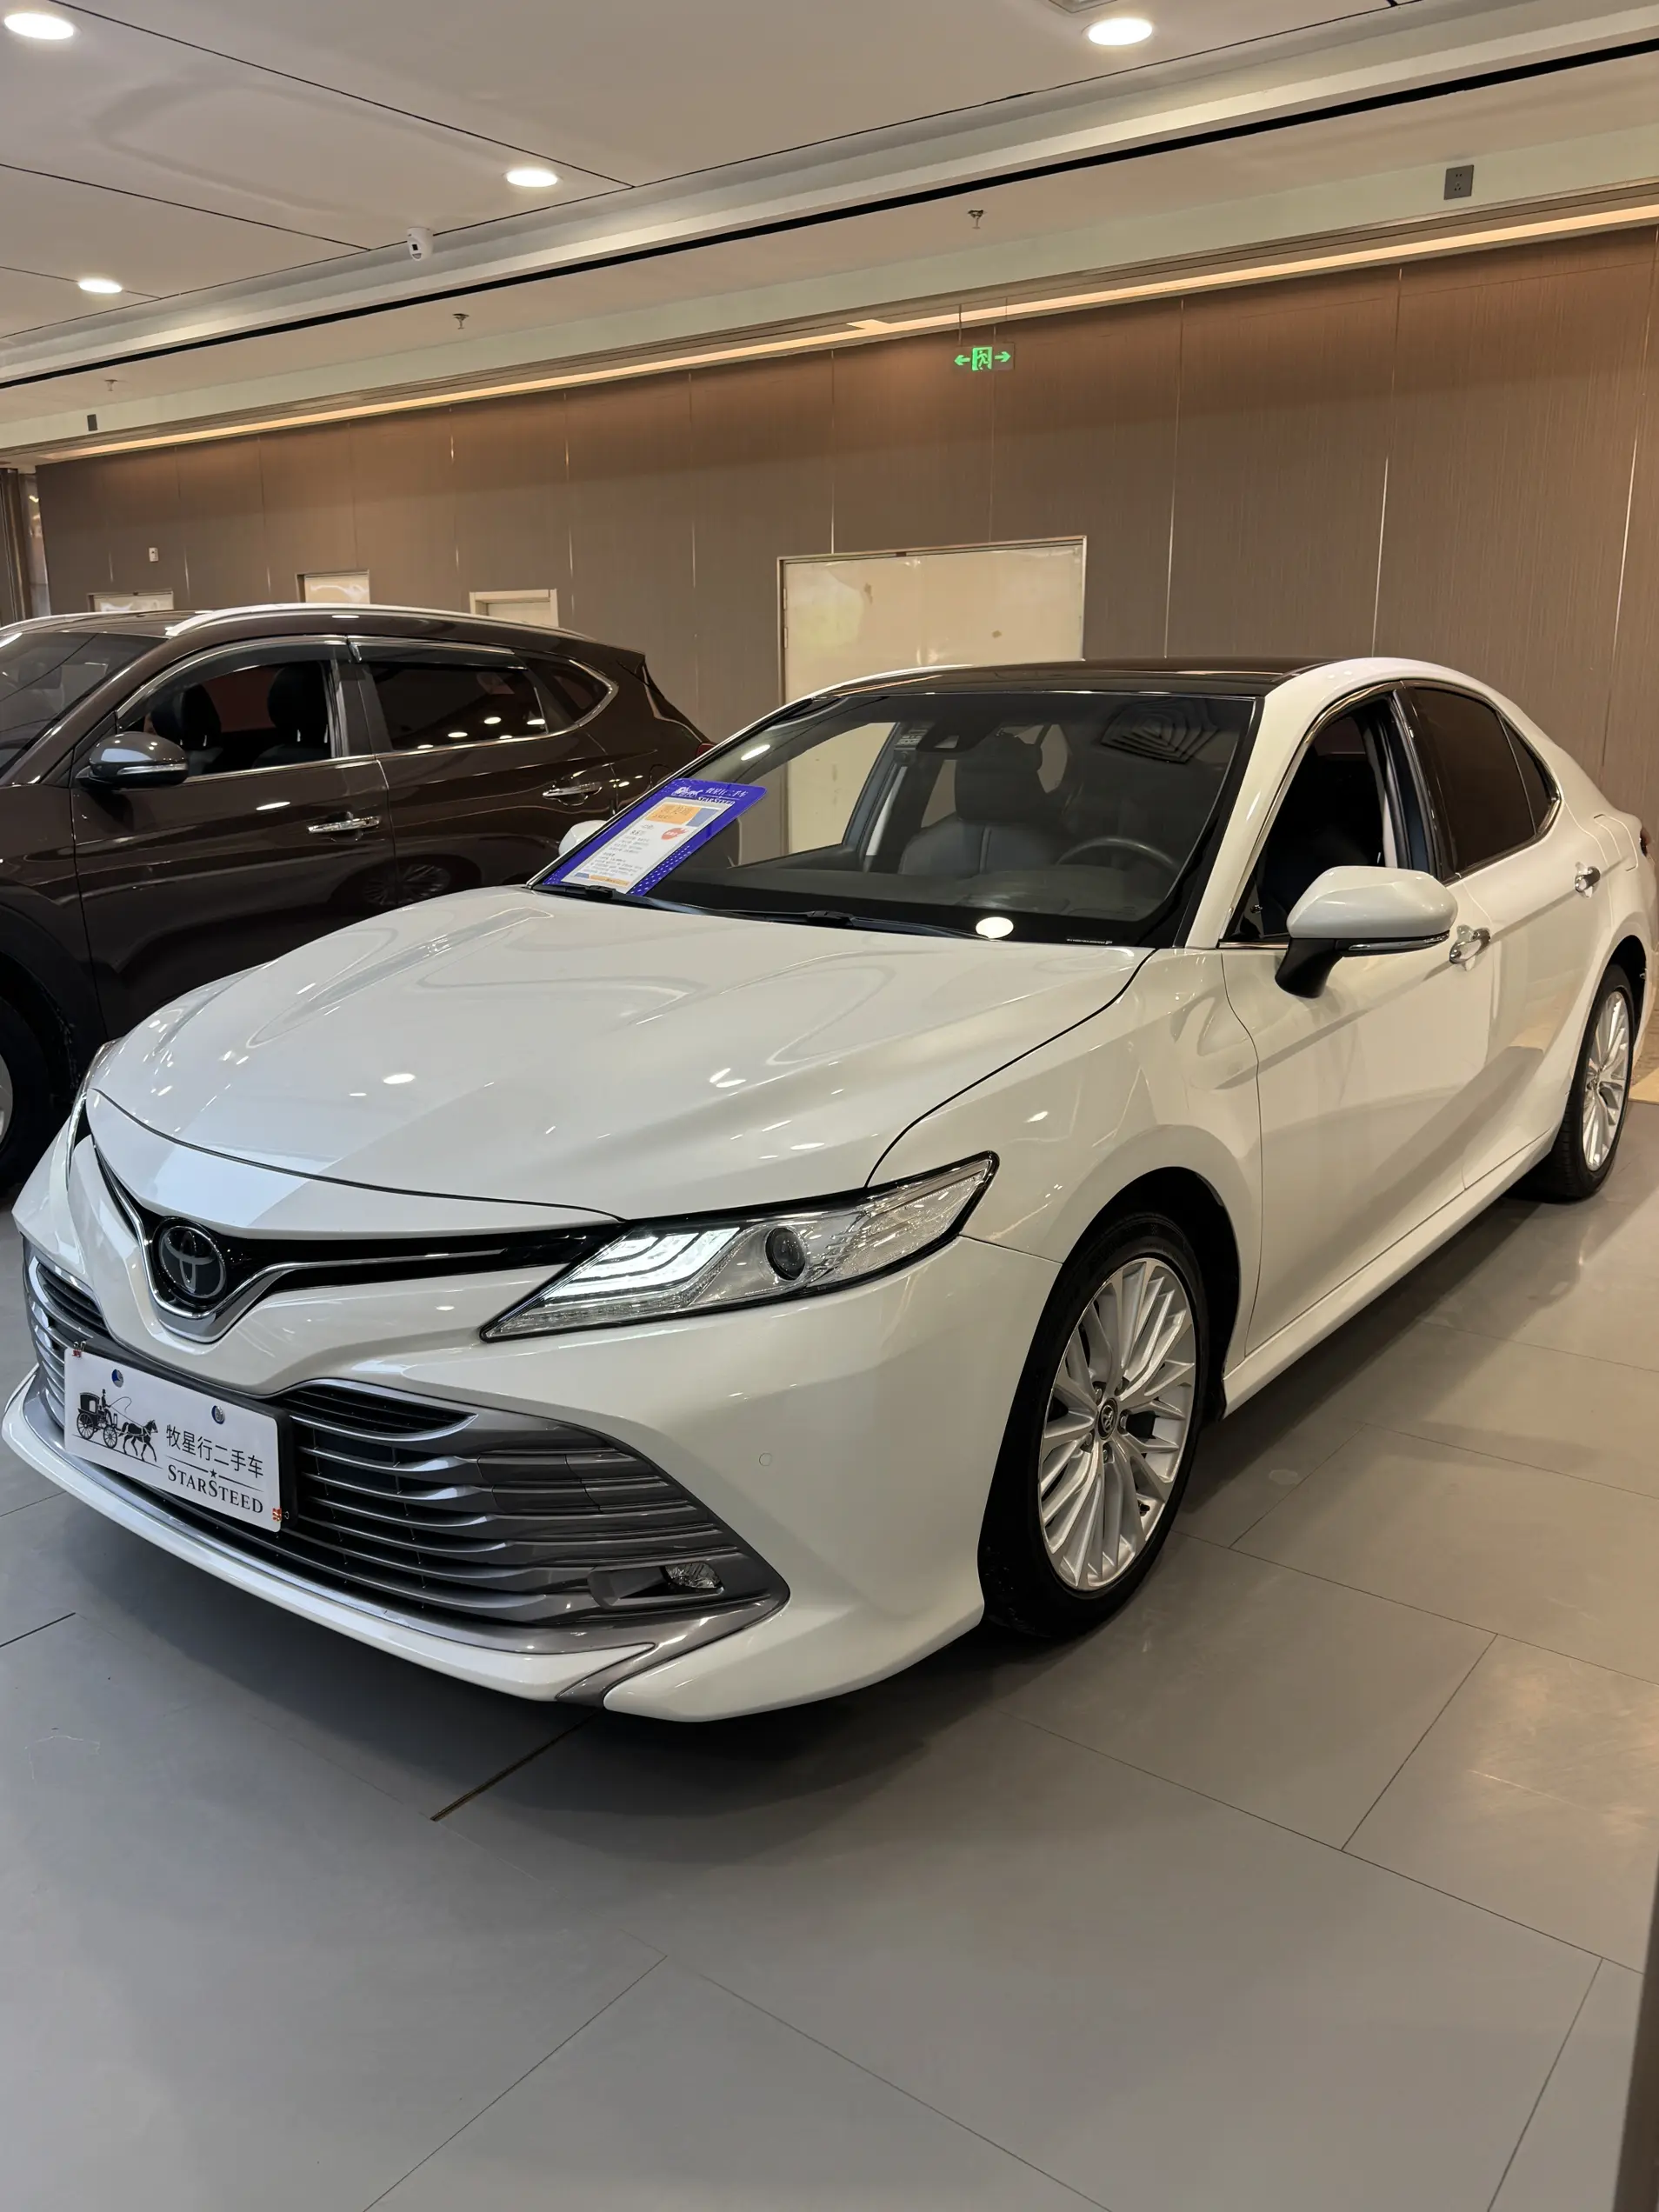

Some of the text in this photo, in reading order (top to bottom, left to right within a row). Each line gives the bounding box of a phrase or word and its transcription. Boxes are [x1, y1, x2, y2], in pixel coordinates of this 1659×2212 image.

[166, 1424, 264, 1479] 牧星行二手车
[167, 1464, 263, 1514] STARSTEED
